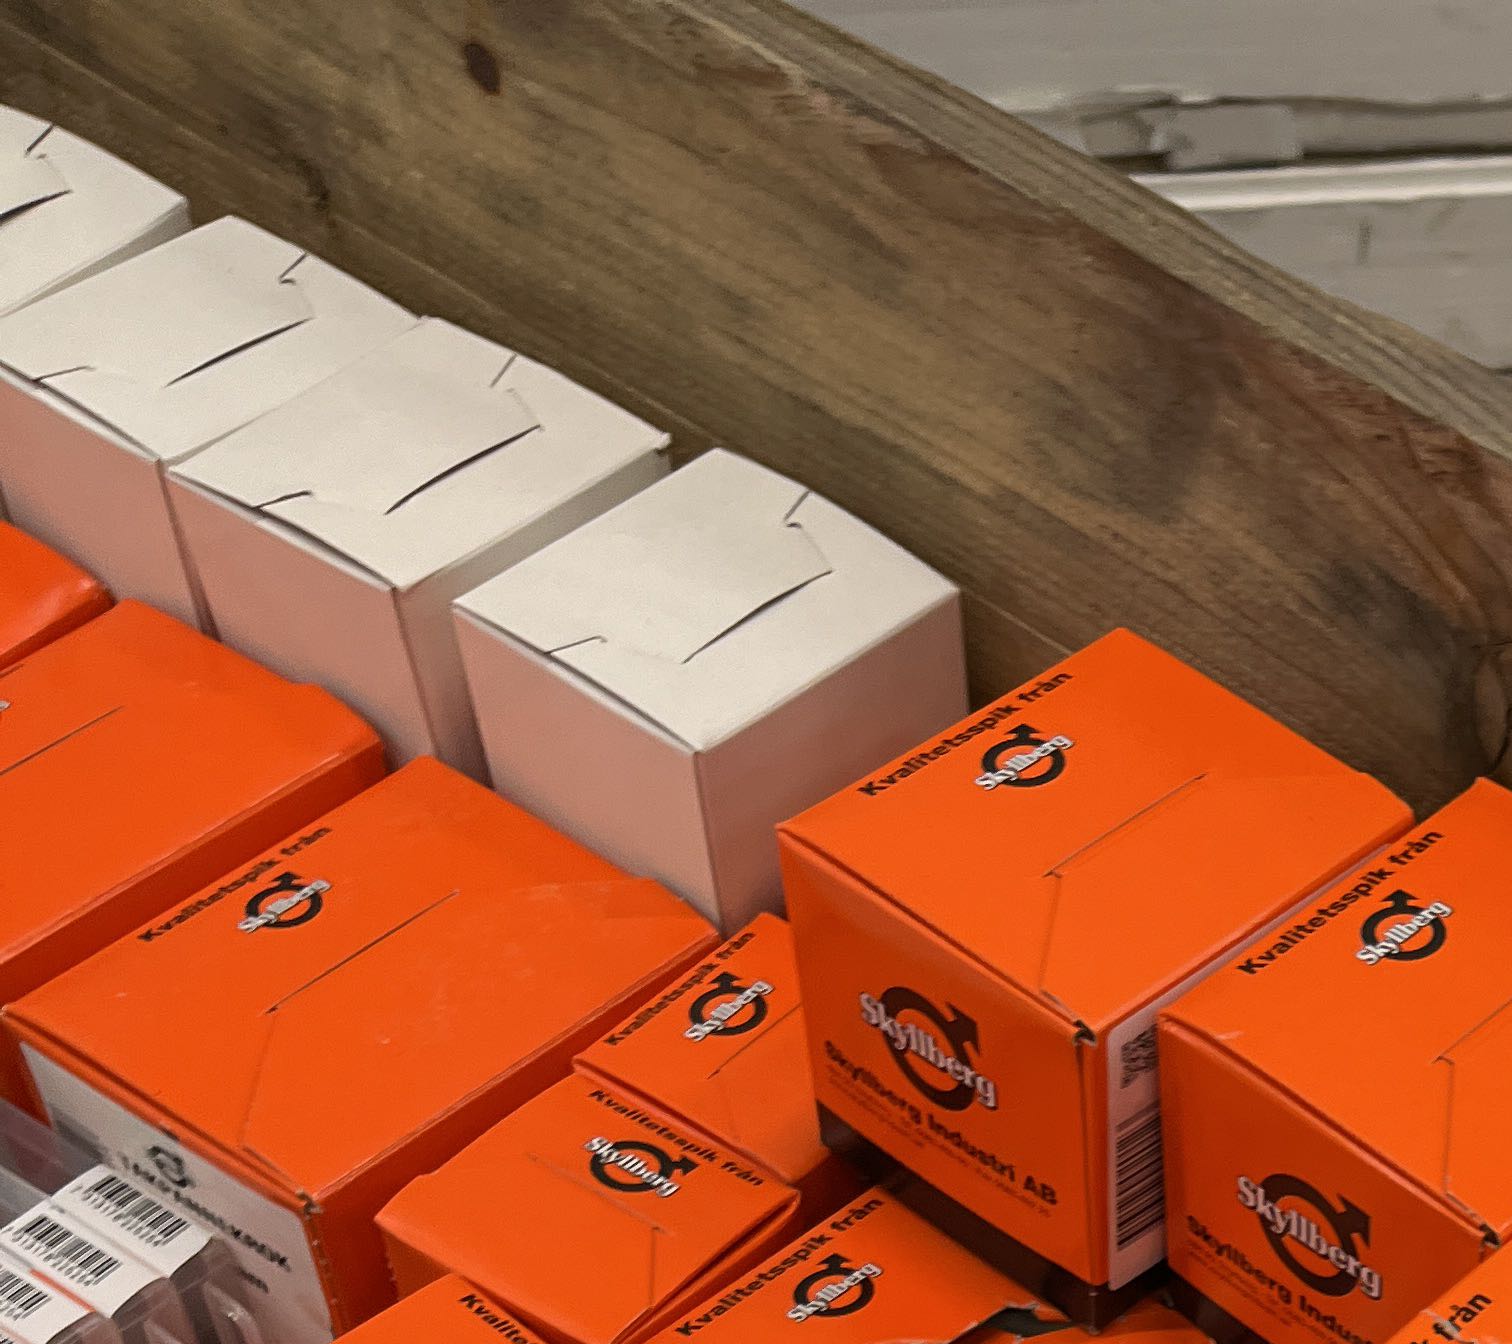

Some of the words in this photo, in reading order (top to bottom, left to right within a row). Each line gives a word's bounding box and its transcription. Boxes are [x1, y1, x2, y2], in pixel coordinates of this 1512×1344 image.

[857, 700, 1019, 797] Kvalitetsspik
[1017, 670, 1073, 708] från
[975, 733, 1073, 791] Skyllberg
[1237, 866, 1393, 975] Kvalitetsspik
[1390, 829, 1443, 869] från
[1355, 900, 1452, 966] Skyllberg
[684, 980, 774, 1041] Skyllberg
[859, 989, 997, 1111] Skyllberg
[583, 1136, 679, 1198] Skyllberg
[588, 1088, 716, 1165] Kvalitetsspik
[717, 1148, 765, 1186] från
[675, 1231, 828, 1337] Kvalitetsspik
[826, 1197, 883, 1240] från
[1237, 1174, 1383, 1300] Skyllberg
[786, 1262, 881, 1323] Skyllberg
